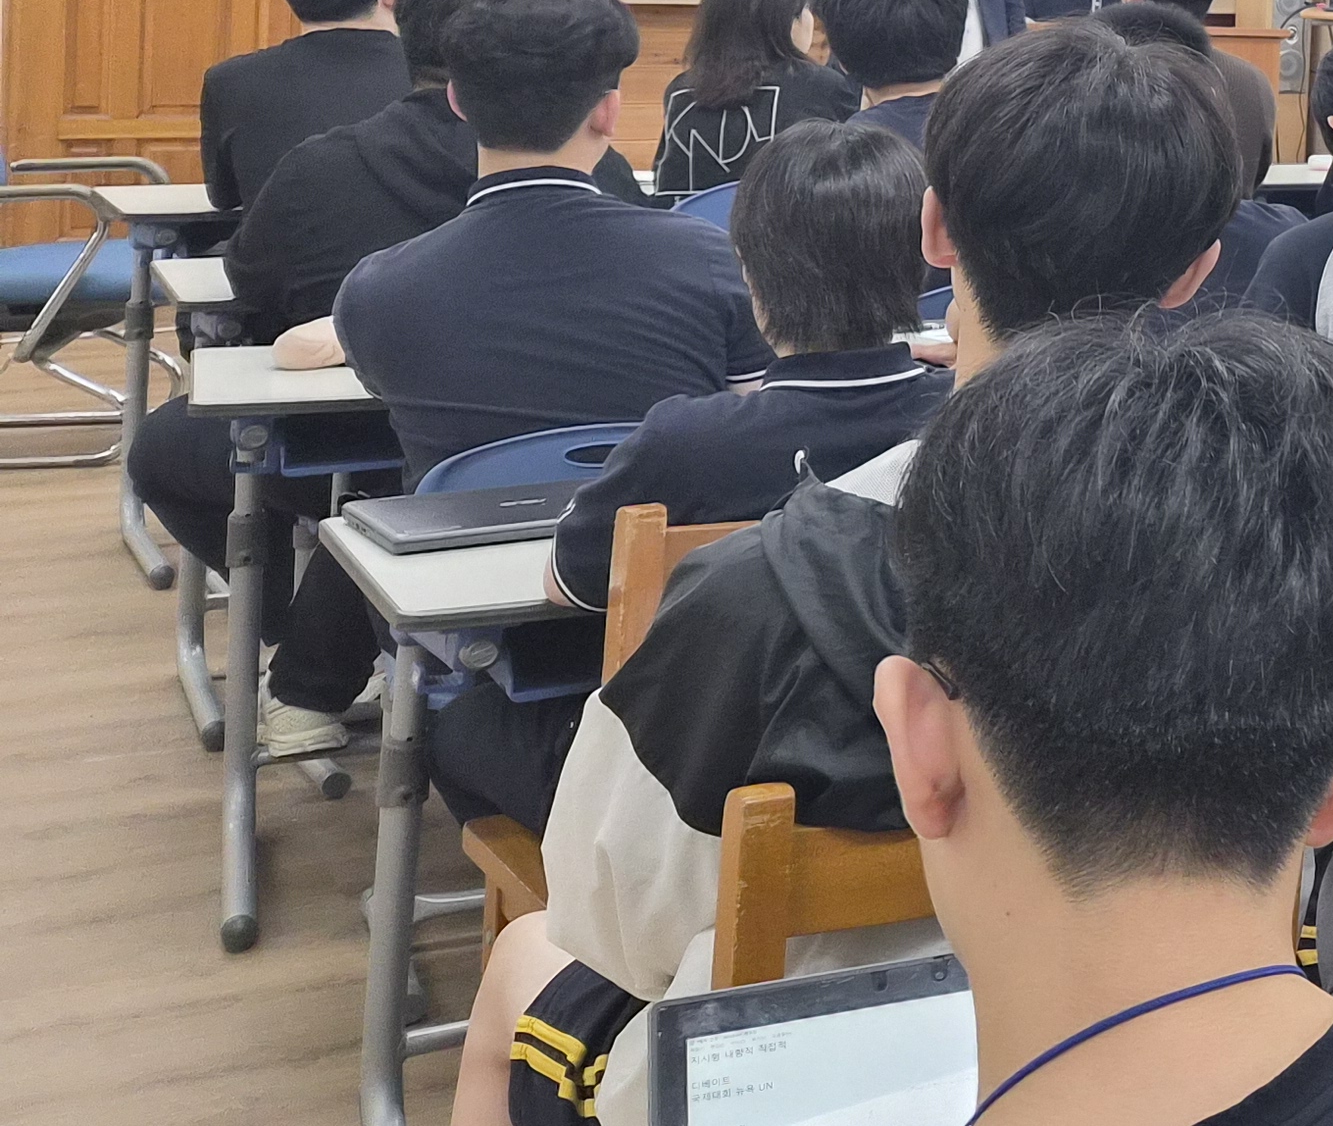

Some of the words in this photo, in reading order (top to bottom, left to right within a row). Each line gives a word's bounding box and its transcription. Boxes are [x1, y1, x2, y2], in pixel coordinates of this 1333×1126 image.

[691, 1076, 731, 1090] 디베이트
[692, 1088, 732, 1102] 국제대회
[735, 1084, 755, 1095] 뉴욕
[759, 1082, 774, 1092] UN
